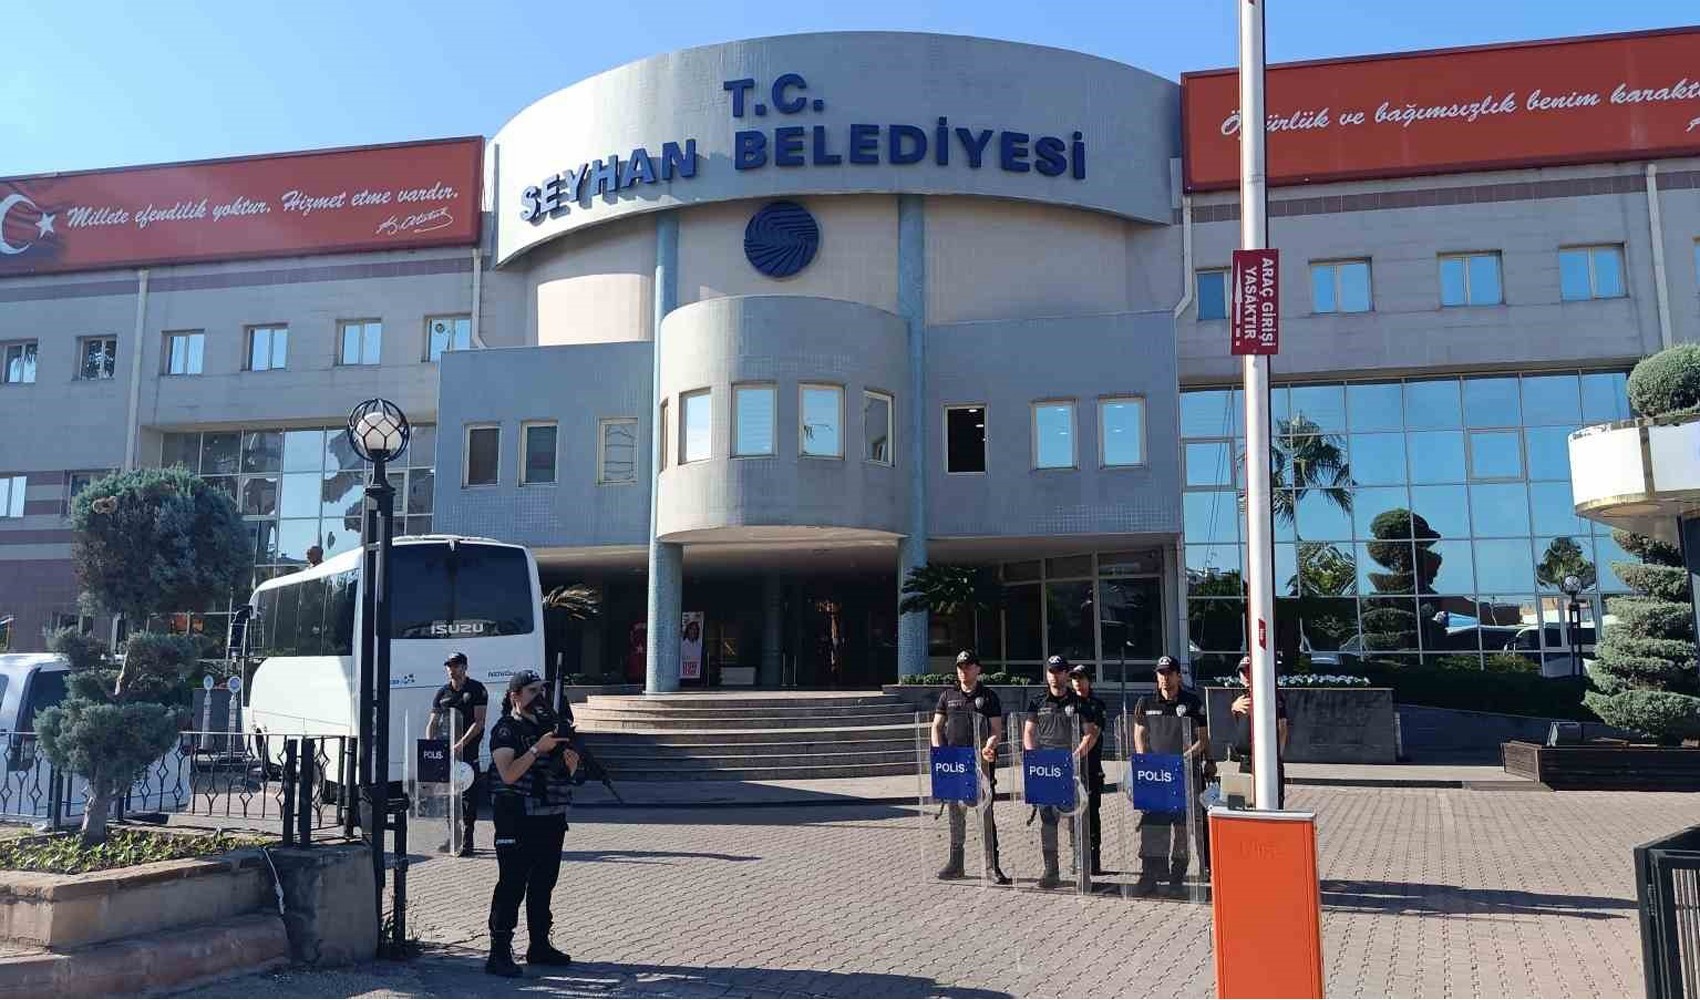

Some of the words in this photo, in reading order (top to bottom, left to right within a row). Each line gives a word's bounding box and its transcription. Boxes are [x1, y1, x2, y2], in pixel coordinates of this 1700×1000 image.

[723, 73, 824, 117] T.C.
[1221, 107, 1330, 140] Öürlük
[1339, 111, 1365, 125] ve
[1374, 92, 1517, 128] bağımsızlık
[1526, 89, 1600, 111] benim
[1610, 78, 1700, 103] karakt
[520, 138, 697, 221] SEYHAN
[735, 116, 1085, 180] BELEDİYESİ
[67, 206, 129, 228] Millete
[134, 199, 208, 228] efendilik
[212, 196, 271, 222] yoktur.
[281, 191, 346, 216] Hizmet
[351, 189, 391, 207] etme
[397, 181, 458, 203] vardır.
[1259, 257, 1274, 298] ARAÇ
[1244, 265, 1258, 340] YASAKTIR
[1259, 302, 1276, 347] GİRİŞİ
[431, 623, 484, 635] ISUZU
